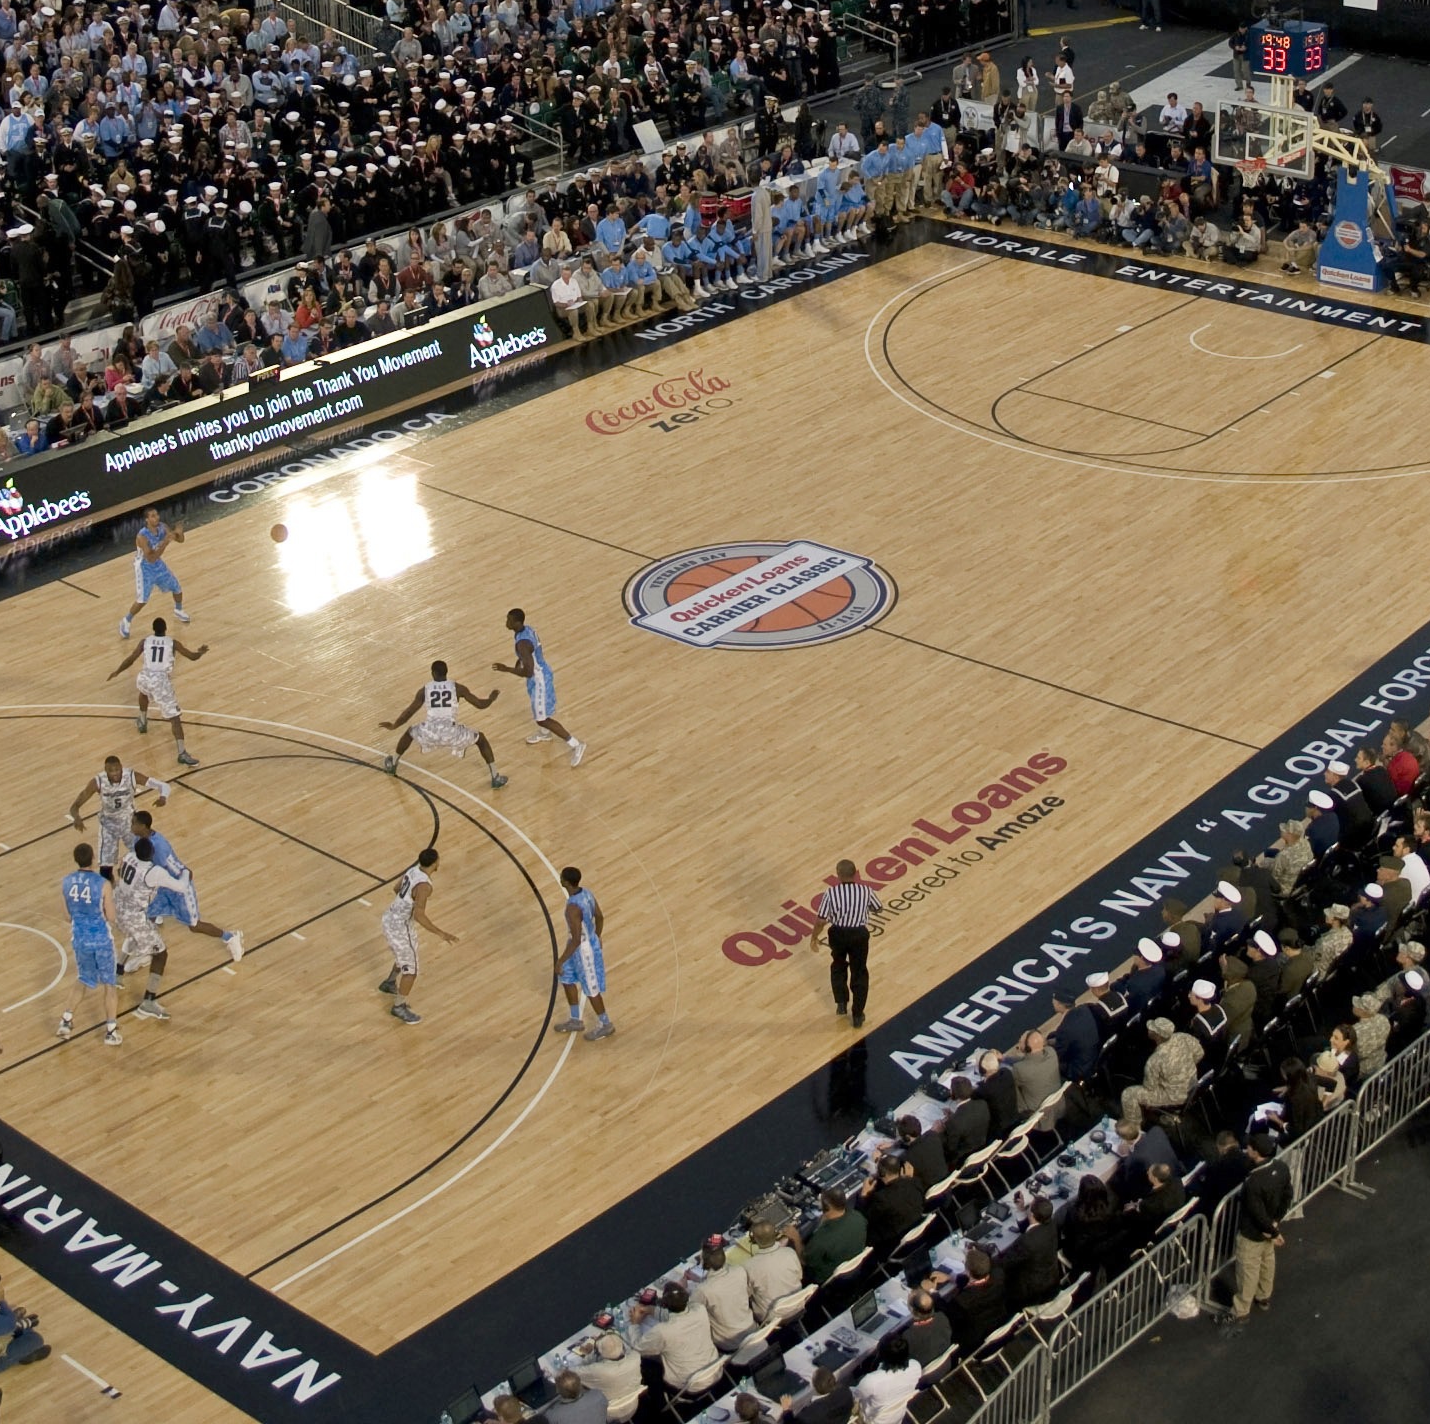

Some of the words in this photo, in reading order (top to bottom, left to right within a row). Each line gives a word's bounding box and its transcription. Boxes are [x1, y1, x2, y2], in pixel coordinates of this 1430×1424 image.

[1261, 33, 1291, 49] 19:48
[1263, 47, 1286, 72] 33
[1305, 46, 1321, 71] 33
[634, 302, 735, 341] NORTH
[739, 250, 869, 300] CAROLINA
[944, 229, 1088, 265] MORALE
[1115, 265, 1423, 334] ENTERTAINMENT
[470, 326, 547, 368] Applebee's
[105, 435, 177, 472] Applebee's
[178, 418, 222, 448] invites
[222, 410, 248, 436] you
[249, 404, 265, 421] to
[268, 393, 292, 419] join
[292, 385, 313, 406] the
[314, 375, 353, 397] Thank
[352, 363, 378, 387] You
[379, 340, 443, 377] Movement
[210, 393, 364, 461] thankyoumovement.com
[648, 397, 733, 433] zero
[650, 560, 698, 590] VETERANS
[700, 552, 726, 565] DAY
[670, 580, 754, 623] Quicken
[746, 554, 810, 587] Loans
[683, 592, 771, 637] CARRIER
[766, 556, 846, 595] CLASSIC
[151, 646, 164, 662] 11
[431, 691, 452, 708] 22
[912, 750, 1068, 845] Loans
[69, 884, 92, 904] 44
[818, 864, 961, 949] gineered
[949, 849, 984, 869] to
[976, 794, 1066, 851] Amaze
[889, 916, 1117, 1080] AMERICA'S
[1099, 839, 1212, 917] NAVY
[1247, 718, 1382, 806] GLOBAL
